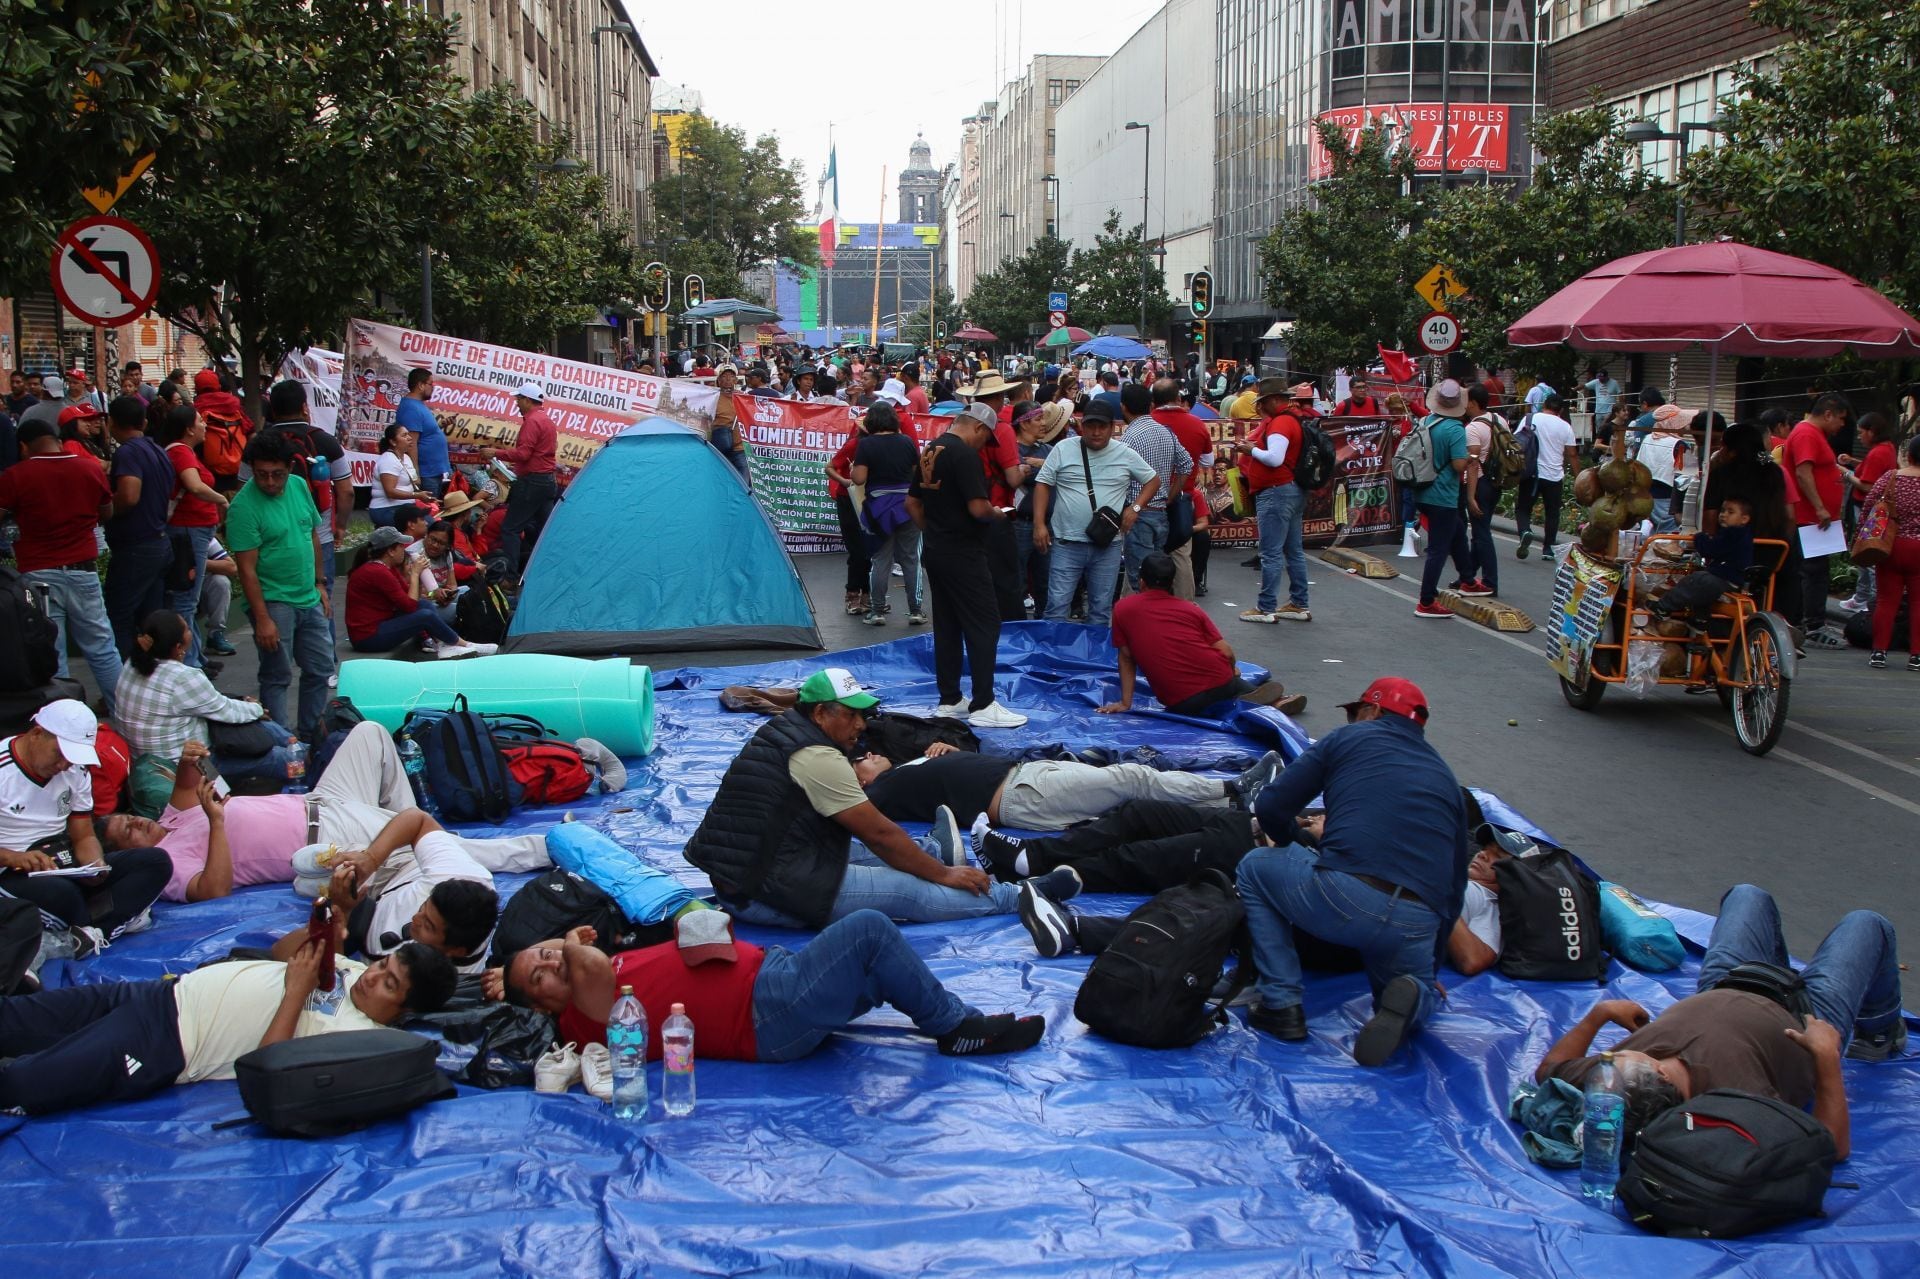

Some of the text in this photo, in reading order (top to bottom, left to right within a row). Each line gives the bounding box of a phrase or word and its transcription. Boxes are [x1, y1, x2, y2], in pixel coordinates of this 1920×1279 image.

[1451, 159, 1458, 167] Y
[1460, 159, 1501, 168] COCTEL
[1429, 322, 1449, 335] 40
[1429, 337, 1449, 345] km/h
[400, 331, 657, 400] COMITÉ DE LUCHA CUAUHTEPEC
[436, 361, 485, 382] ESCUELA
[546, 382, 628, 411] QUETZALCOATL
[430, 385, 509, 414] BROGACIÓN
[566, 410, 589, 432] DEL
[473, 423, 493, 440] DE
[749, 426, 804, 446] COMITÉ
[806, 431, 824, 449] DE
[752, 446, 773, 458] XIGE
[1346, 456, 1383, 470] CNTE
[777, 497, 818, 508] SALARIAL
[1349, 486, 1388, 509] 1989
[1558, 887, 1580, 961] adidas
